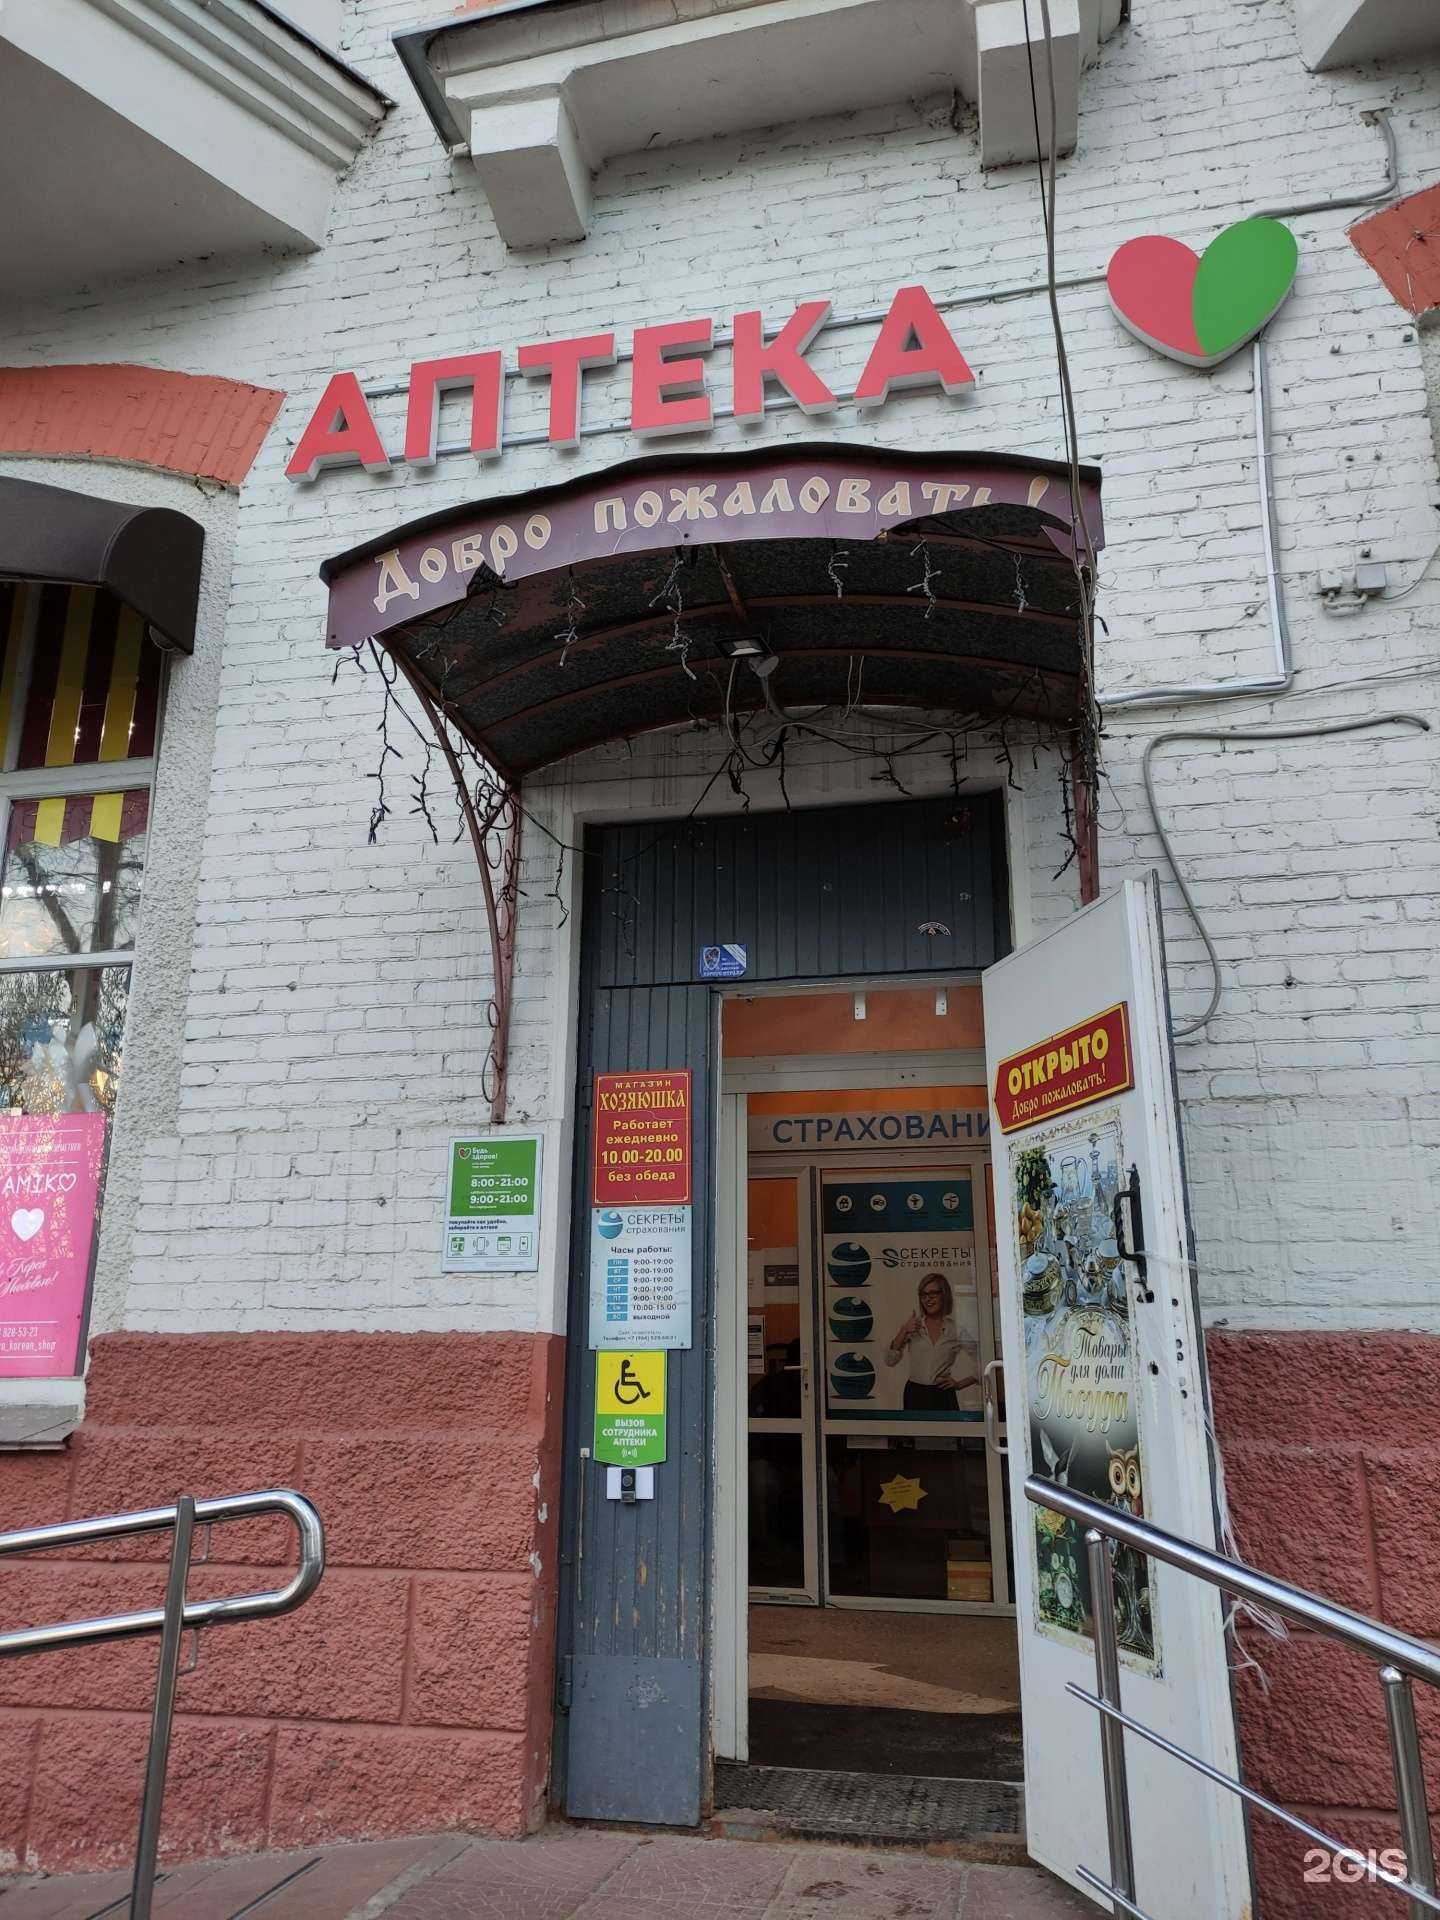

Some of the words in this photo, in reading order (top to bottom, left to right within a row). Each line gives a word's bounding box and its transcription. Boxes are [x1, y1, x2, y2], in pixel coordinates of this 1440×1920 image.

[285, 286, 975, 483] АПТЕКА
[373, 514, 551, 613] Добро
[1008, 1028, 1109, 1095] ОТКРЫТО
[615, 1080, 672, 1088] МАГАЗИН
[1012, 1098, 1039, 1120] Добро
[1042, 1062, 1107, 1106] пожаловать!
[600, 1090, 686, 1112] ХОЗЯЮШКА
[613, 1120, 674, 1130] Работает
[606, 1134, 678, 1144] ежедневно
[601, 1148, 683, 1164] 10.00-20.00
[608, 1171, 631, 1181] без
[635, 1170, 676, 1181] обеда
[470, 1178, 529, 1187] 8:00-21:00
[470, 1194, 528, 1204] 9:00-21:00
[627, 1213, 685, 1225] СЕКРЕТЫ
[626, 1227, 686, 1235] страхования
[610, 1246, 634, 1254] Часы
[637, 1245, 673, 1255] работы:
[900, 1247, 971, 1259] СЕКРЕТЫ
[1073, 1327, 1127, 1363] Товары
[1070, 1365, 1089, 1384] для
[1095, 1365, 1125, 1384] дома
[1033, 1353, 1128, 1433] Посуда
[615, 1419, 646, 1427] ВЫЗОВ
[602, 1428, 657, 1437] СОТРУДНИКА
[613, 1438, 647, 1446] АПТЕКИ
